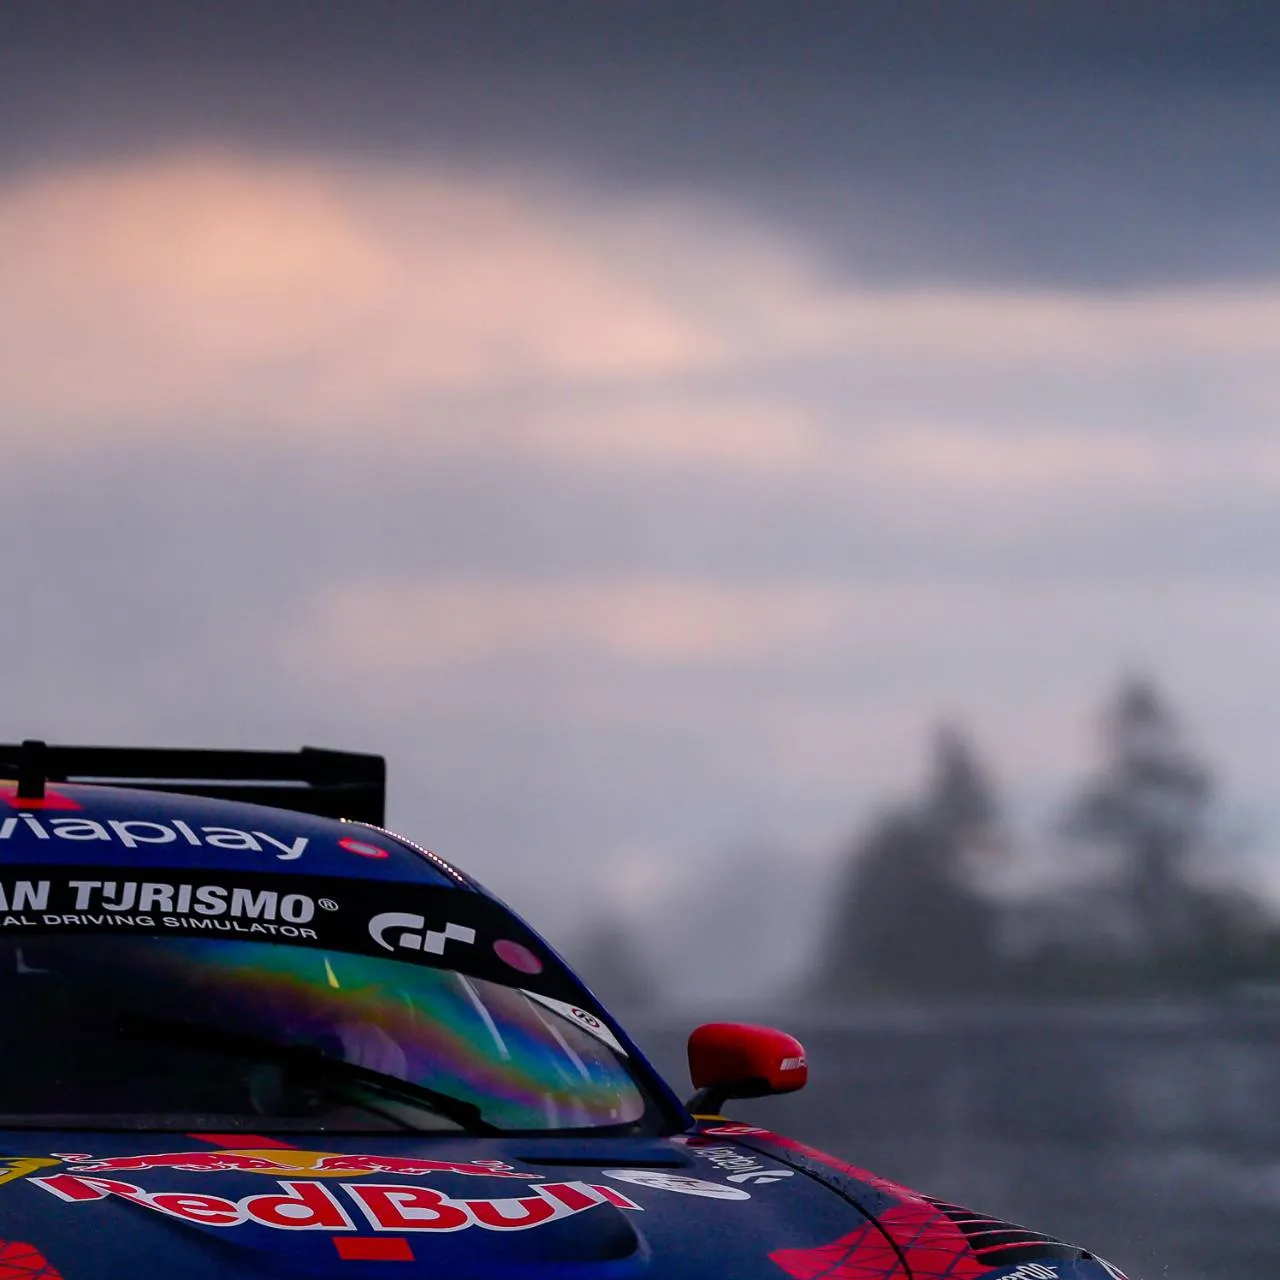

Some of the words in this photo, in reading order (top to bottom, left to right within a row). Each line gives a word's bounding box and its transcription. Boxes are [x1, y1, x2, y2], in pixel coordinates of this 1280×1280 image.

[43, 915, 156, 927] DRIVING
[163, 916, 318, 940] SIMULATOR
[369, 912, 475, 955] GT
[26, 1173, 357, 1230] Red
[352, 1181, 644, 1230] Bull
